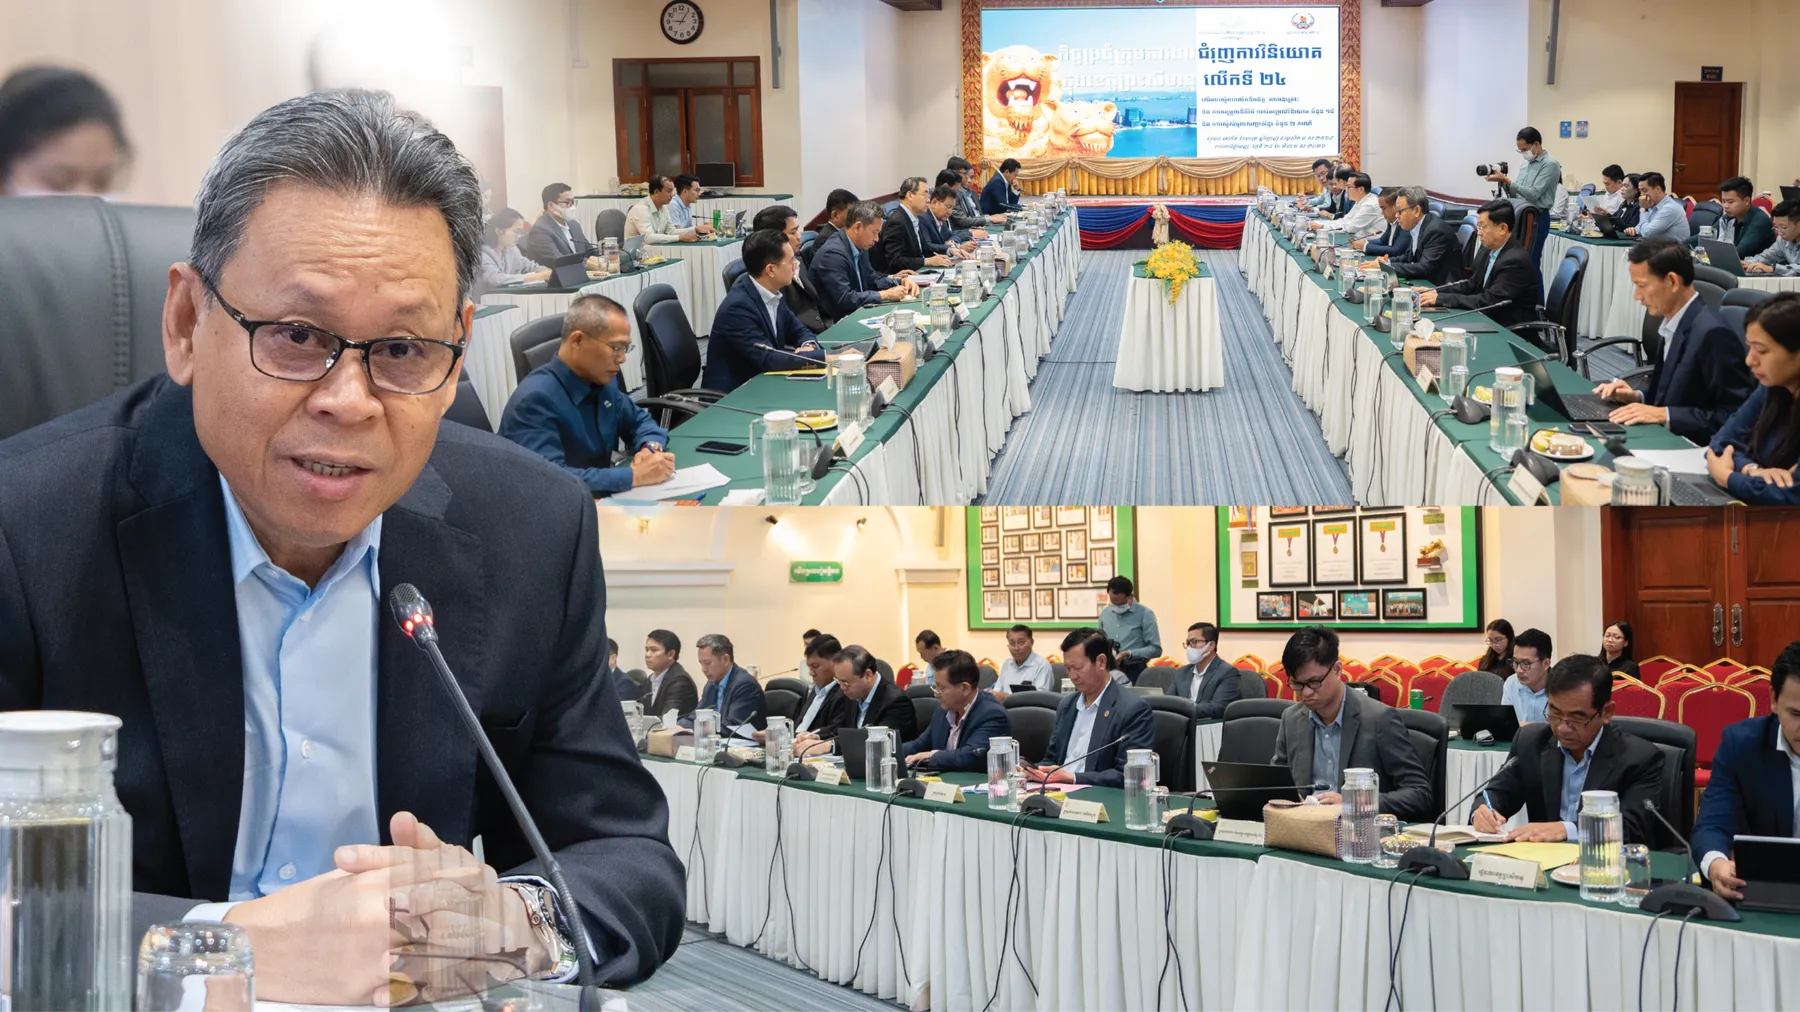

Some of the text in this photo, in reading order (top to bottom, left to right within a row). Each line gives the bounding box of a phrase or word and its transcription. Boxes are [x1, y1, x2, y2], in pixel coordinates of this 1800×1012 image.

[1198, 42, 1322, 63] ជំរុញការវិនិយោគ
[1204, 70, 1253, 86] លើកទី
[1260, 72, 1287, 86] ២៤
